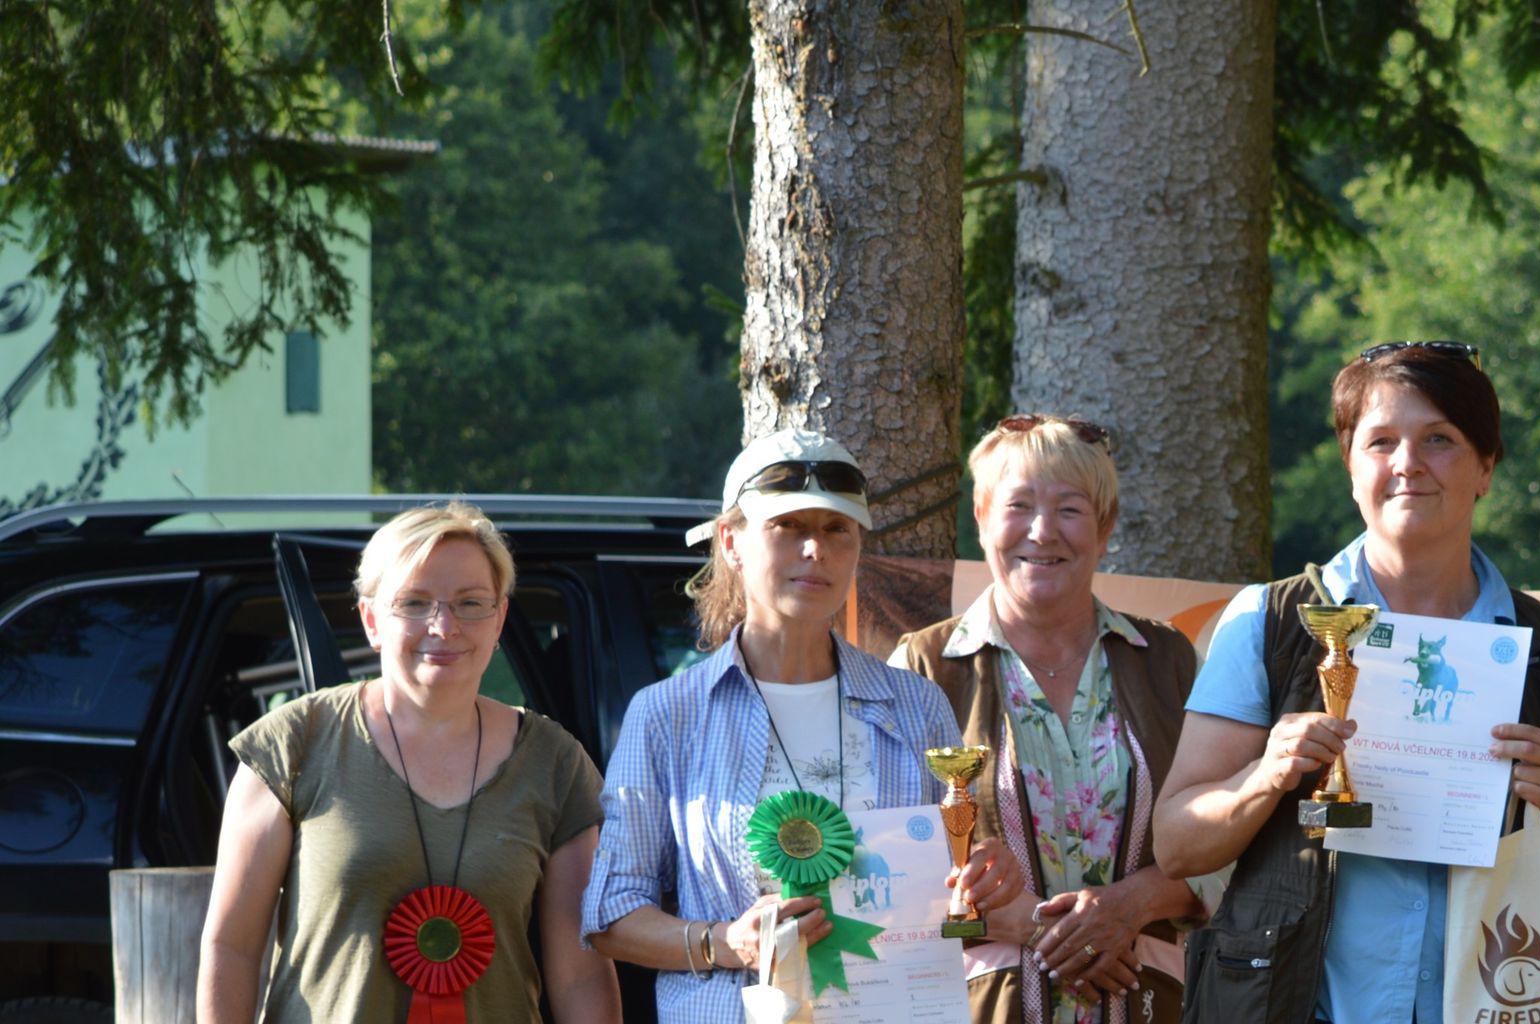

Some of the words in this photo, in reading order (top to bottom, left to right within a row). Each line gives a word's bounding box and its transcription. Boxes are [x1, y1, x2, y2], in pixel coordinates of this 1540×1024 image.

[1353, 738, 1368, 747] WT
[1371, 740, 1400, 752] NOVÁ
[1404, 742, 1453, 758] VČELNICE
